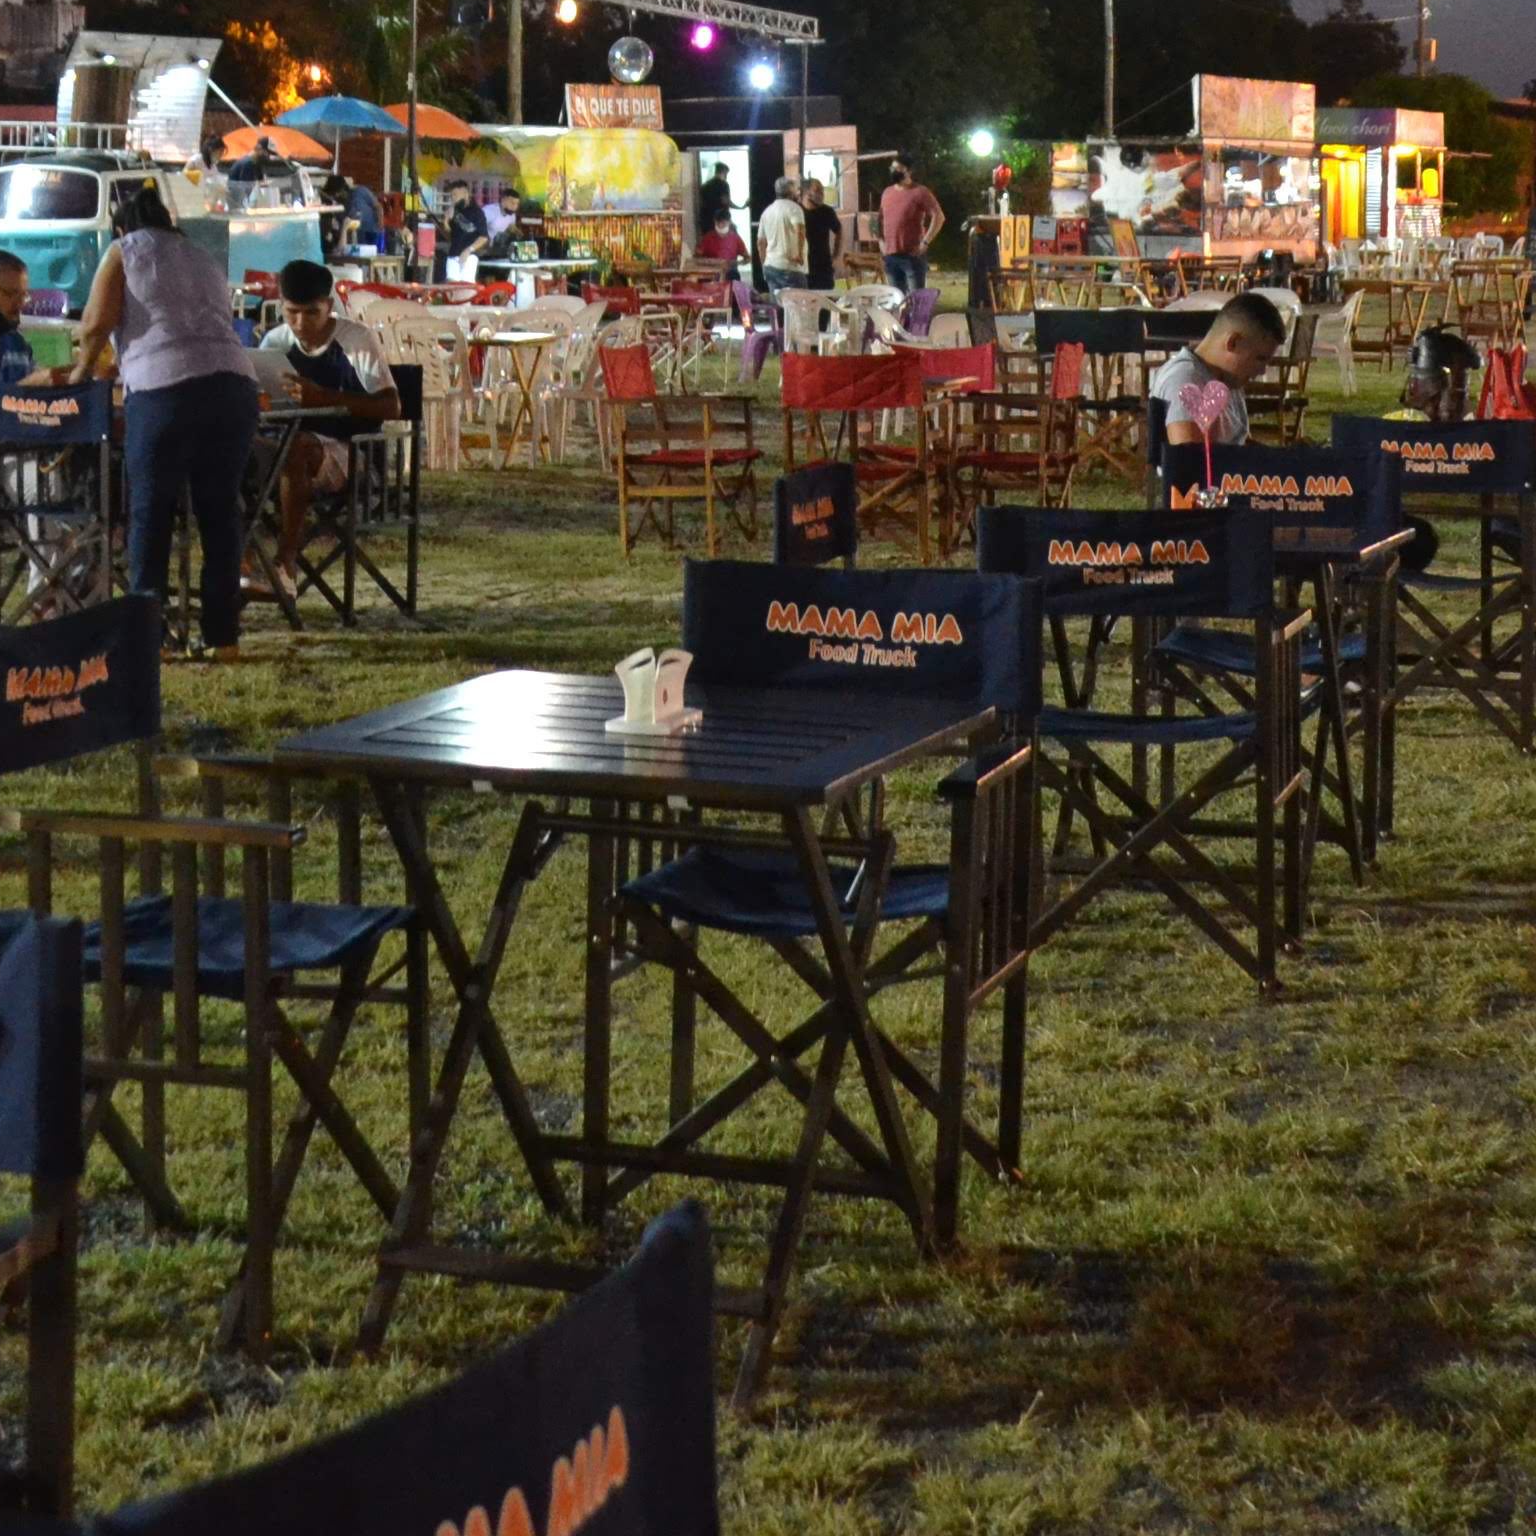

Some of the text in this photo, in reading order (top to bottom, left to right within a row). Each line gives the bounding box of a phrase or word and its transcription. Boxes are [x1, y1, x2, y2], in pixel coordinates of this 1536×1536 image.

[590, 98, 615, 115] QUE
[616, 98, 630, 115] TE
[1351, 116, 1392, 135] chori
[1381, 440, 1496, 460] MAMA MIA
[1405, 459, 1470, 475] Food Truck
[1221, 473, 1353, 496] MAMA MIA
[1250, 496, 1326, 512] Food Truck
[1048, 539, 1211, 564] MAMA MIA
[1083, 567, 1175, 585] Food Truck
[766, 600, 964, 645] MAMA MIA
[808, 638, 917, 668] Food Truck
[546, 1404, 630, 1536] MIA
